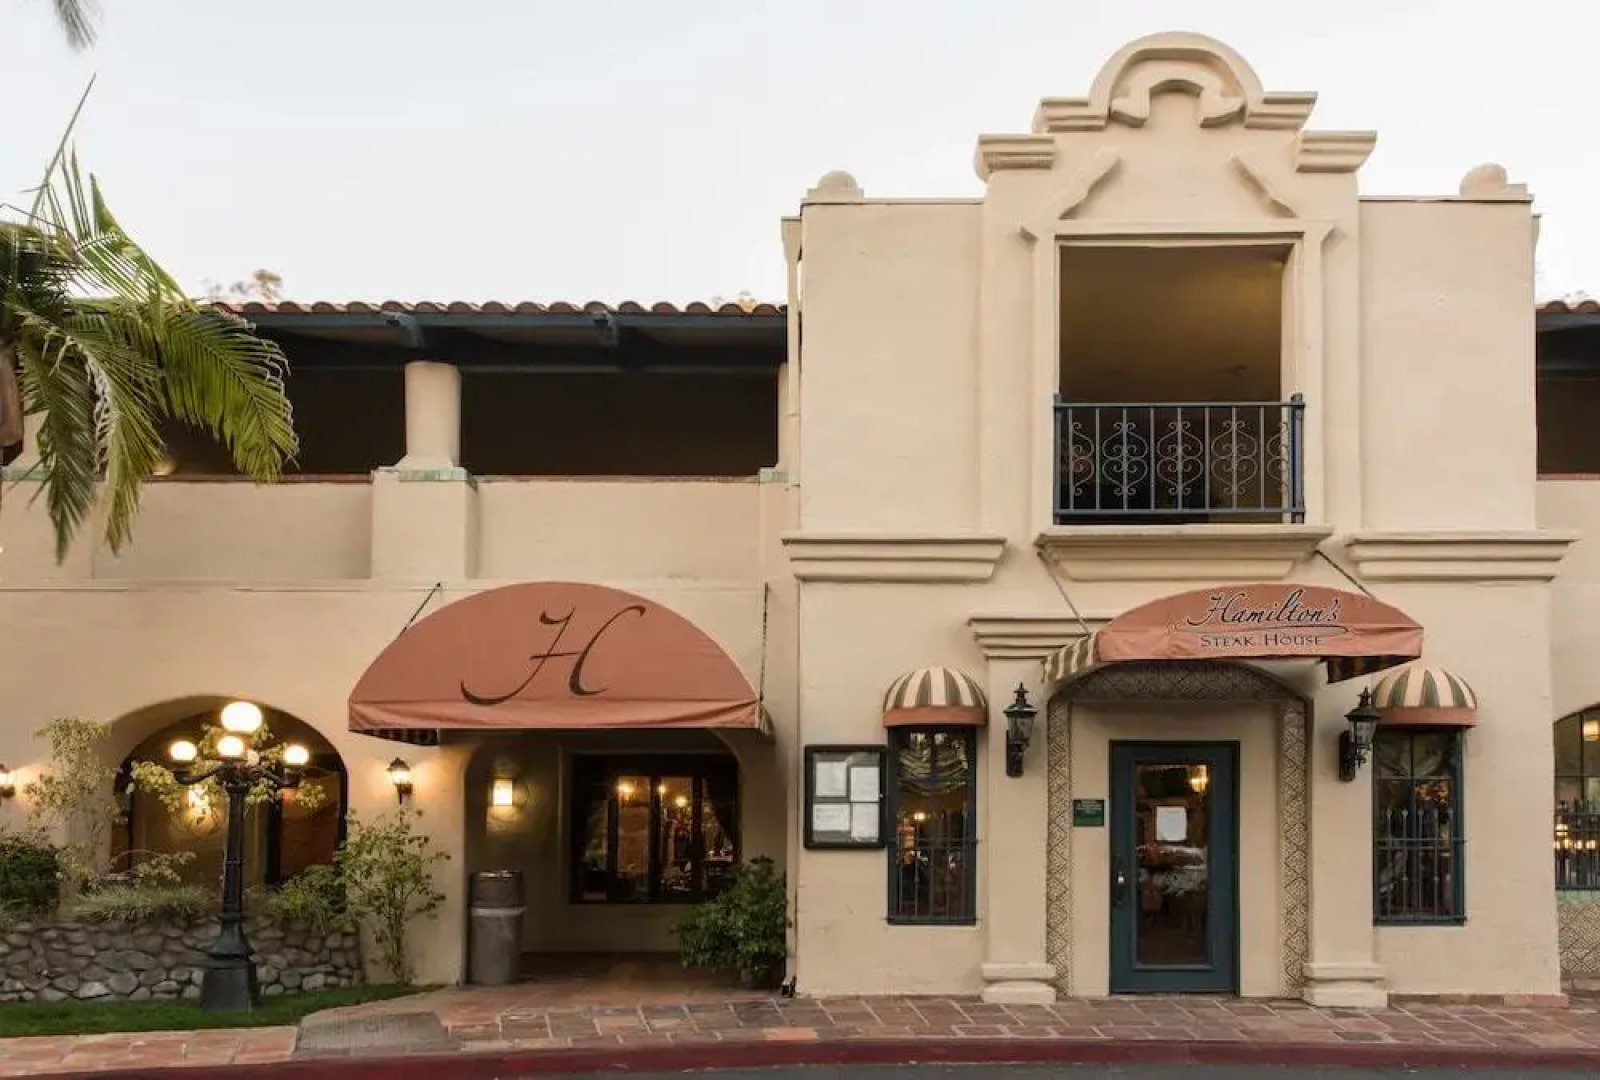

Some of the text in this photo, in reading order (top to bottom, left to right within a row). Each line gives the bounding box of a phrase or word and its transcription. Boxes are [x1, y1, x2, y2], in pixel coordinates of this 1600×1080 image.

[1186, 588, 1340, 626] Hamilton's
[460, 604, 646, 706] H
[1201, 633, 1323, 647] STEAK HOUSE
